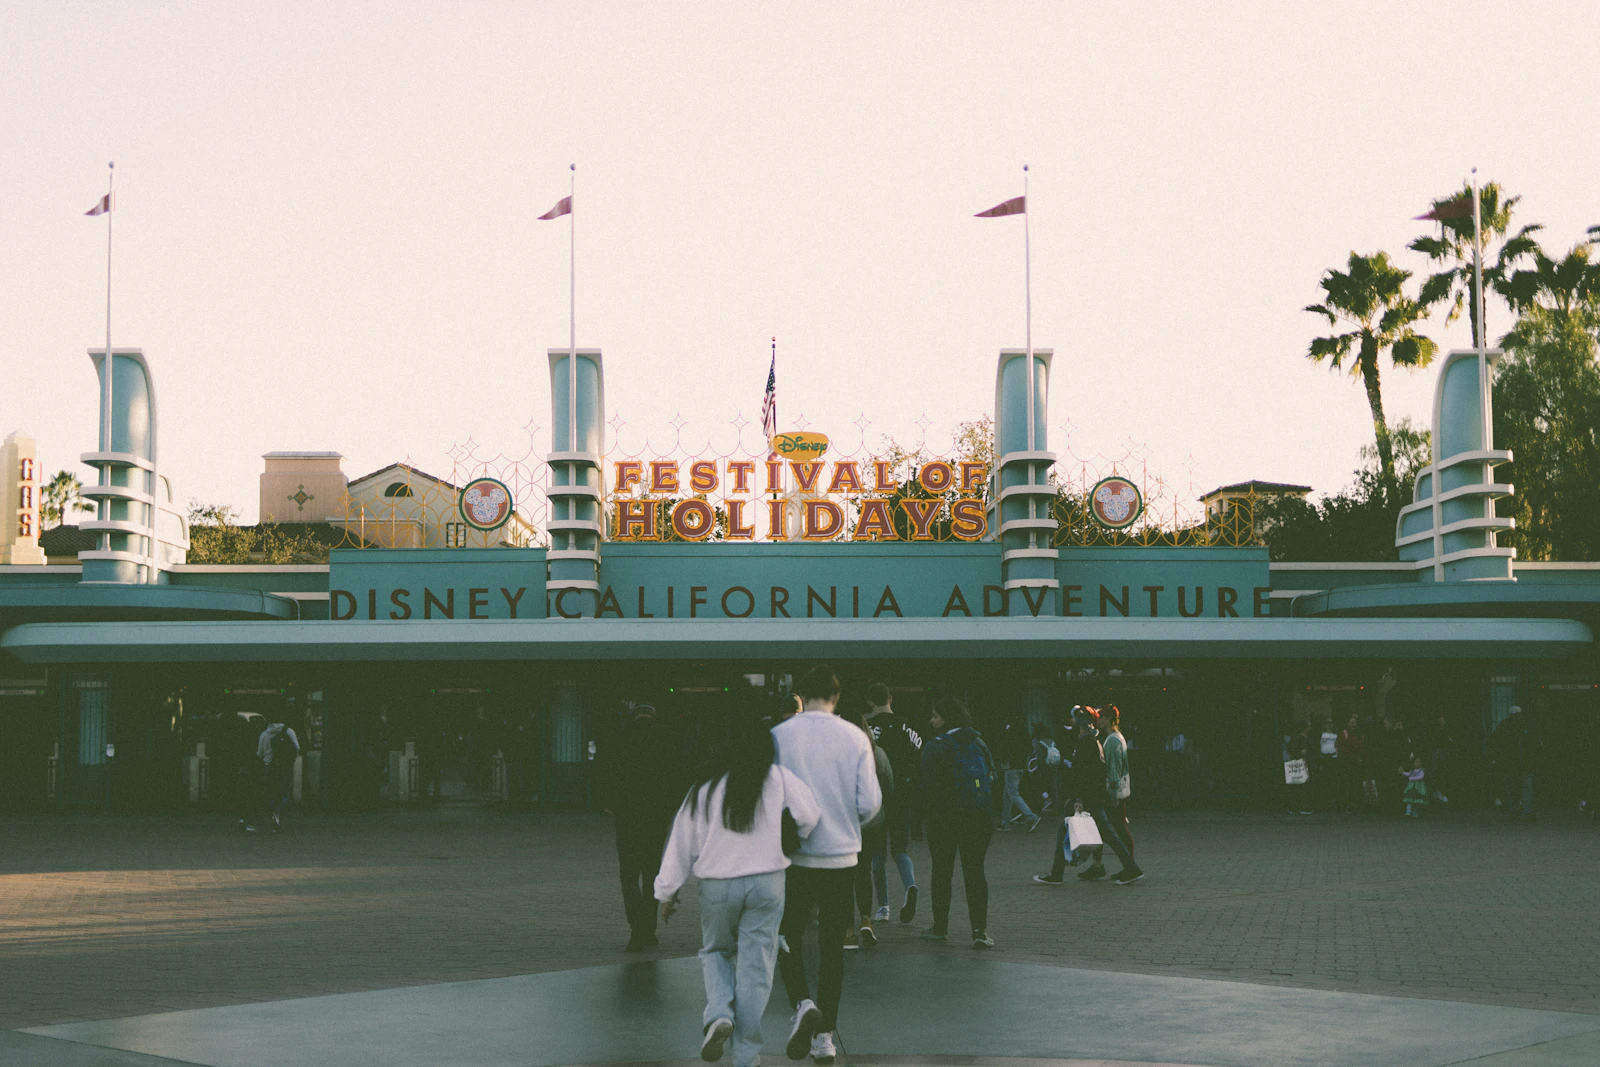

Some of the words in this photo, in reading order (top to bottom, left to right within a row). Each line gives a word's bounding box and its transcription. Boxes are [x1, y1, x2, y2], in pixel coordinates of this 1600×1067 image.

[775, 434, 828, 456] Disney
[614, 461, 898, 494] FESTIVAL
[919, 461, 989, 494] OF
[20, 458, 33, 536] GAS
[615, 499, 989, 541] HOLIDAYS
[331, 587, 526, 620] DISNEY
[555, 584, 904, 619] CALIFORNIA
[942, 584, 1273, 618] ADVENTURE
